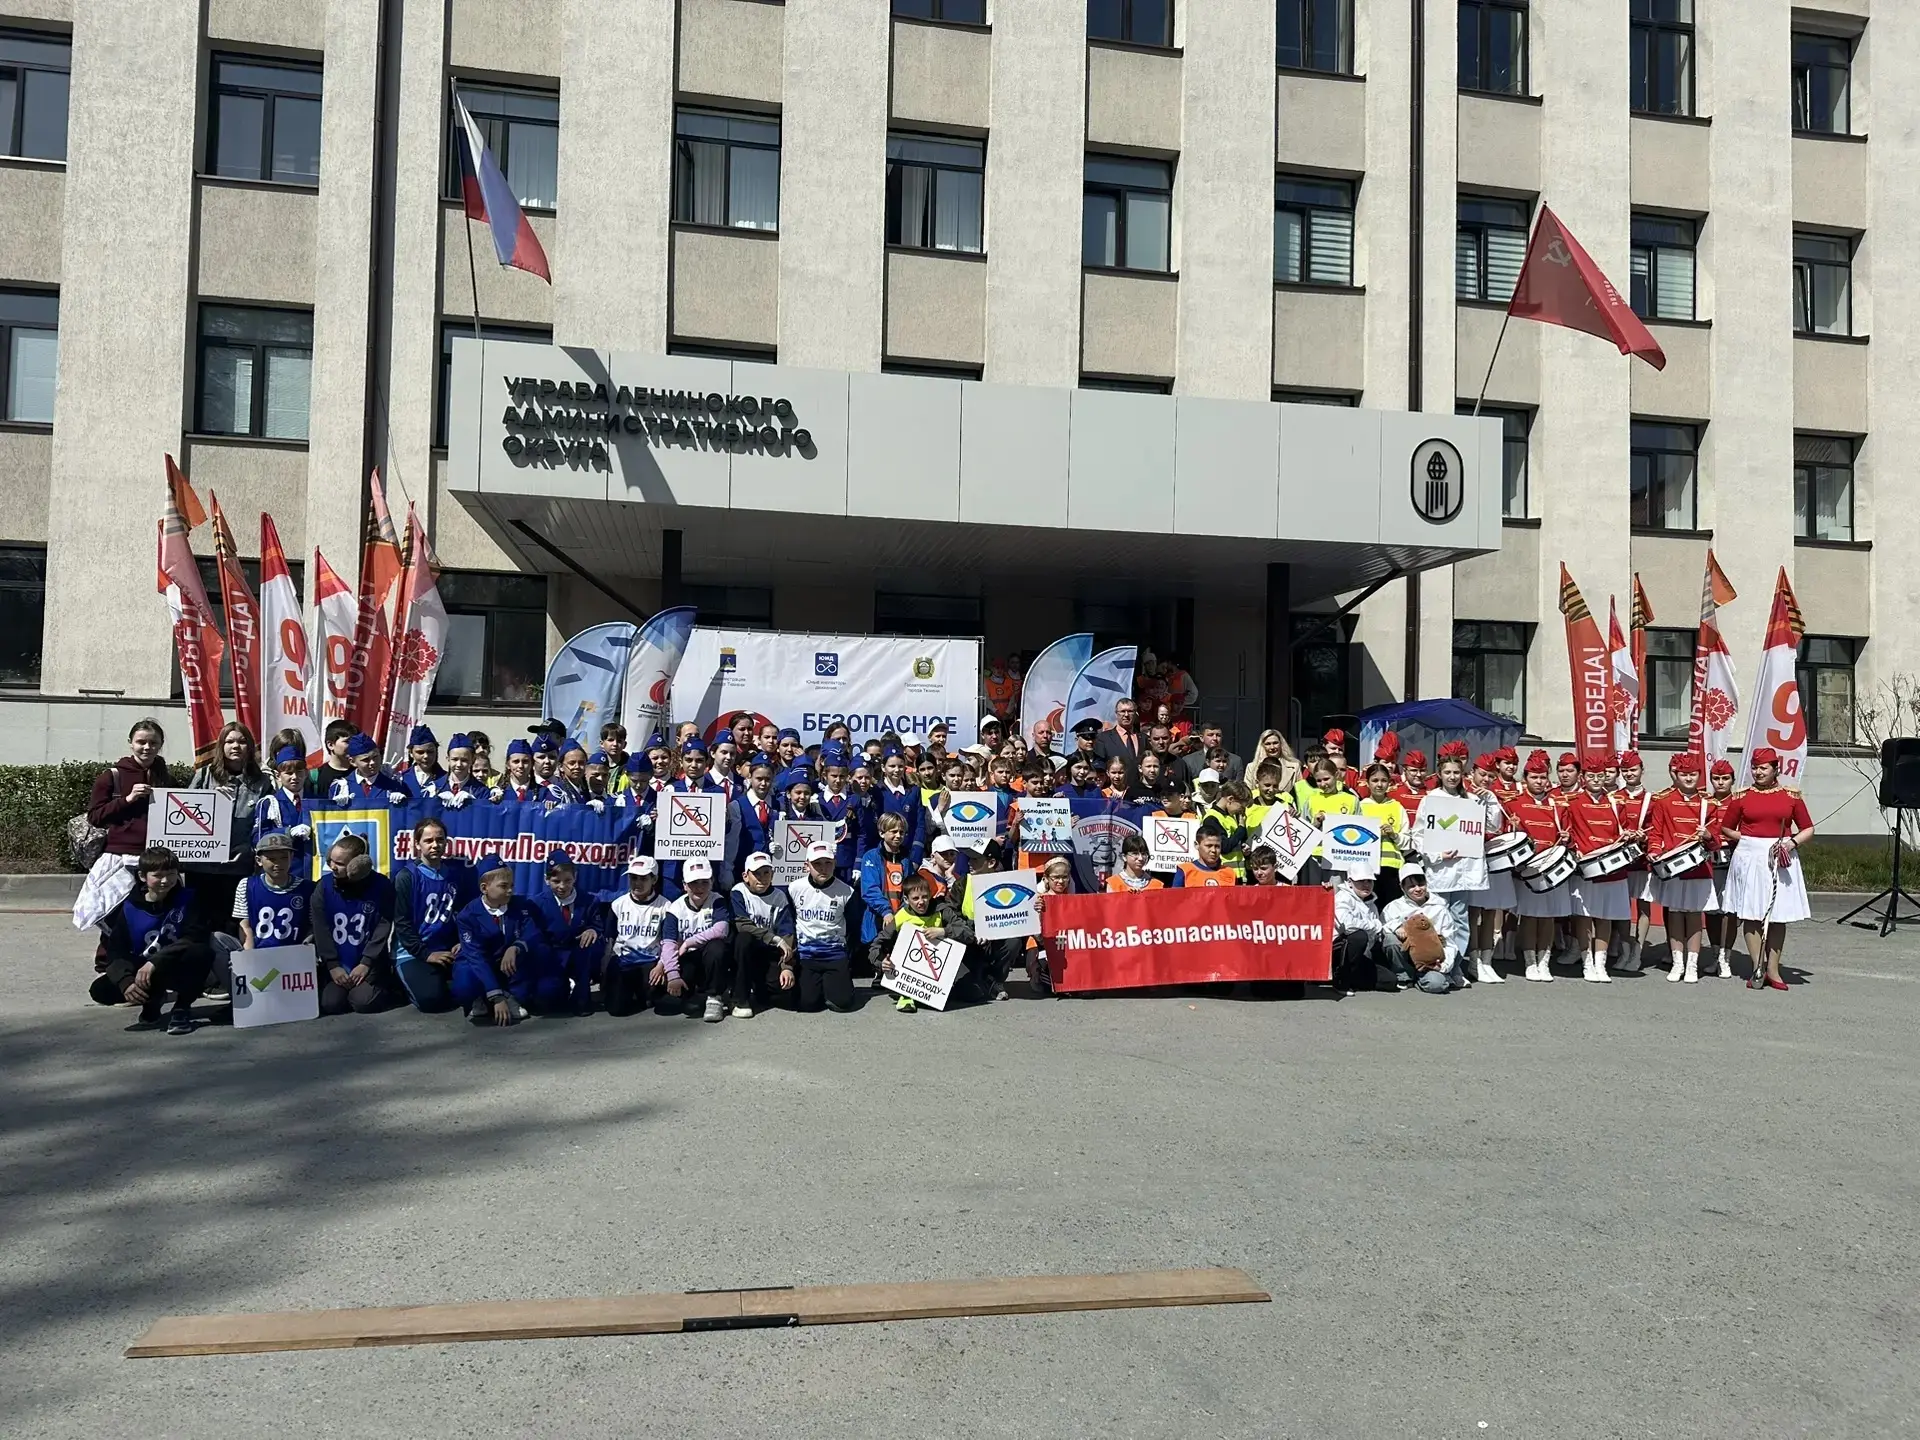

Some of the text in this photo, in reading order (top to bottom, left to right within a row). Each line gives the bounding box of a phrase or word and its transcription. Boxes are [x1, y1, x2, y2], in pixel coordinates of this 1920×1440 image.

[503, 376, 793, 417] УПРАВА ЛЕНИНСКОГО
[502, 406, 812, 447] АДМИНИСТРАТИВНОГО
[502, 435, 607, 462] ОКРУГА
[283, 696, 308, 717] МА
[1583, 647, 1608, 748] ПОБЕДА!
[324, 701, 347, 718] МА
[1766, 680, 1808, 752] 9
[1427, 814, 1483, 836] Я ПДД
[149, 839, 165, 849] ПО
[172, 849, 211, 859] ЕШКОМ
[657, 839, 669, 848] ПО
[669, 849, 709, 858] ПЕШКОМ
[1331, 848, 1371, 857] ВНИМАНИЕ
[1154, 862, 1177, 870] ПЕШК
[256, 906, 294, 941] 83
[799, 908, 836, 922] ТЮМЕНЬ
[984, 910, 1030, 922] ВНИМАНИЕ
[998, 918, 1028, 929] ДОРОГУ!
[332, 911, 366, 947] 83
[619, 923, 658, 938] ТЮМЕНЬ
[1054, 918, 1324, 951] #МыЗаБезопасныеДороги
[235, 971, 315, 995] Я ПДД
[895, 980, 932, 1002] ПЕШКОМ
